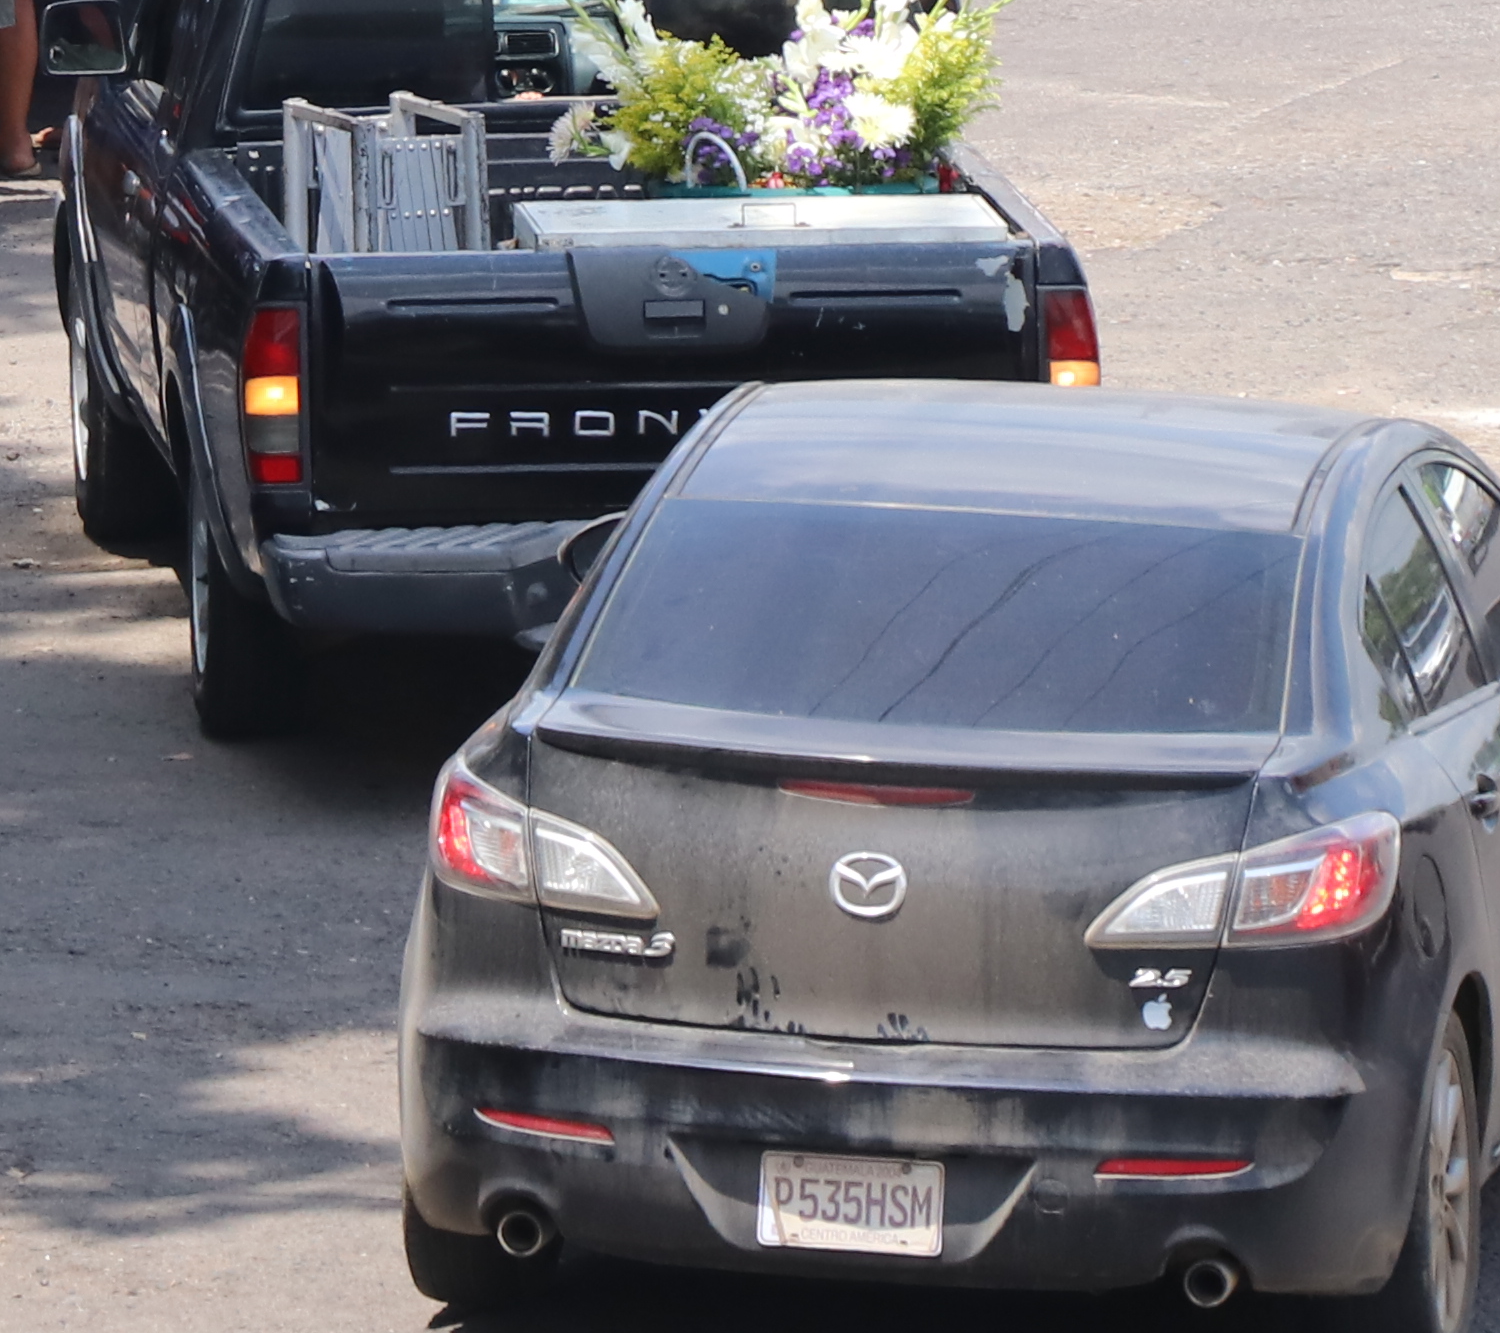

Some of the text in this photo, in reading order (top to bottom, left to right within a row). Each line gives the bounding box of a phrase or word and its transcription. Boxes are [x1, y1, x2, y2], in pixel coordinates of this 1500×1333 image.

[450, 408, 710, 438] FRON
[1128, 967, 1193, 989] 2.5
[800, 1227, 900, 1246] CENTRO AMERICA
